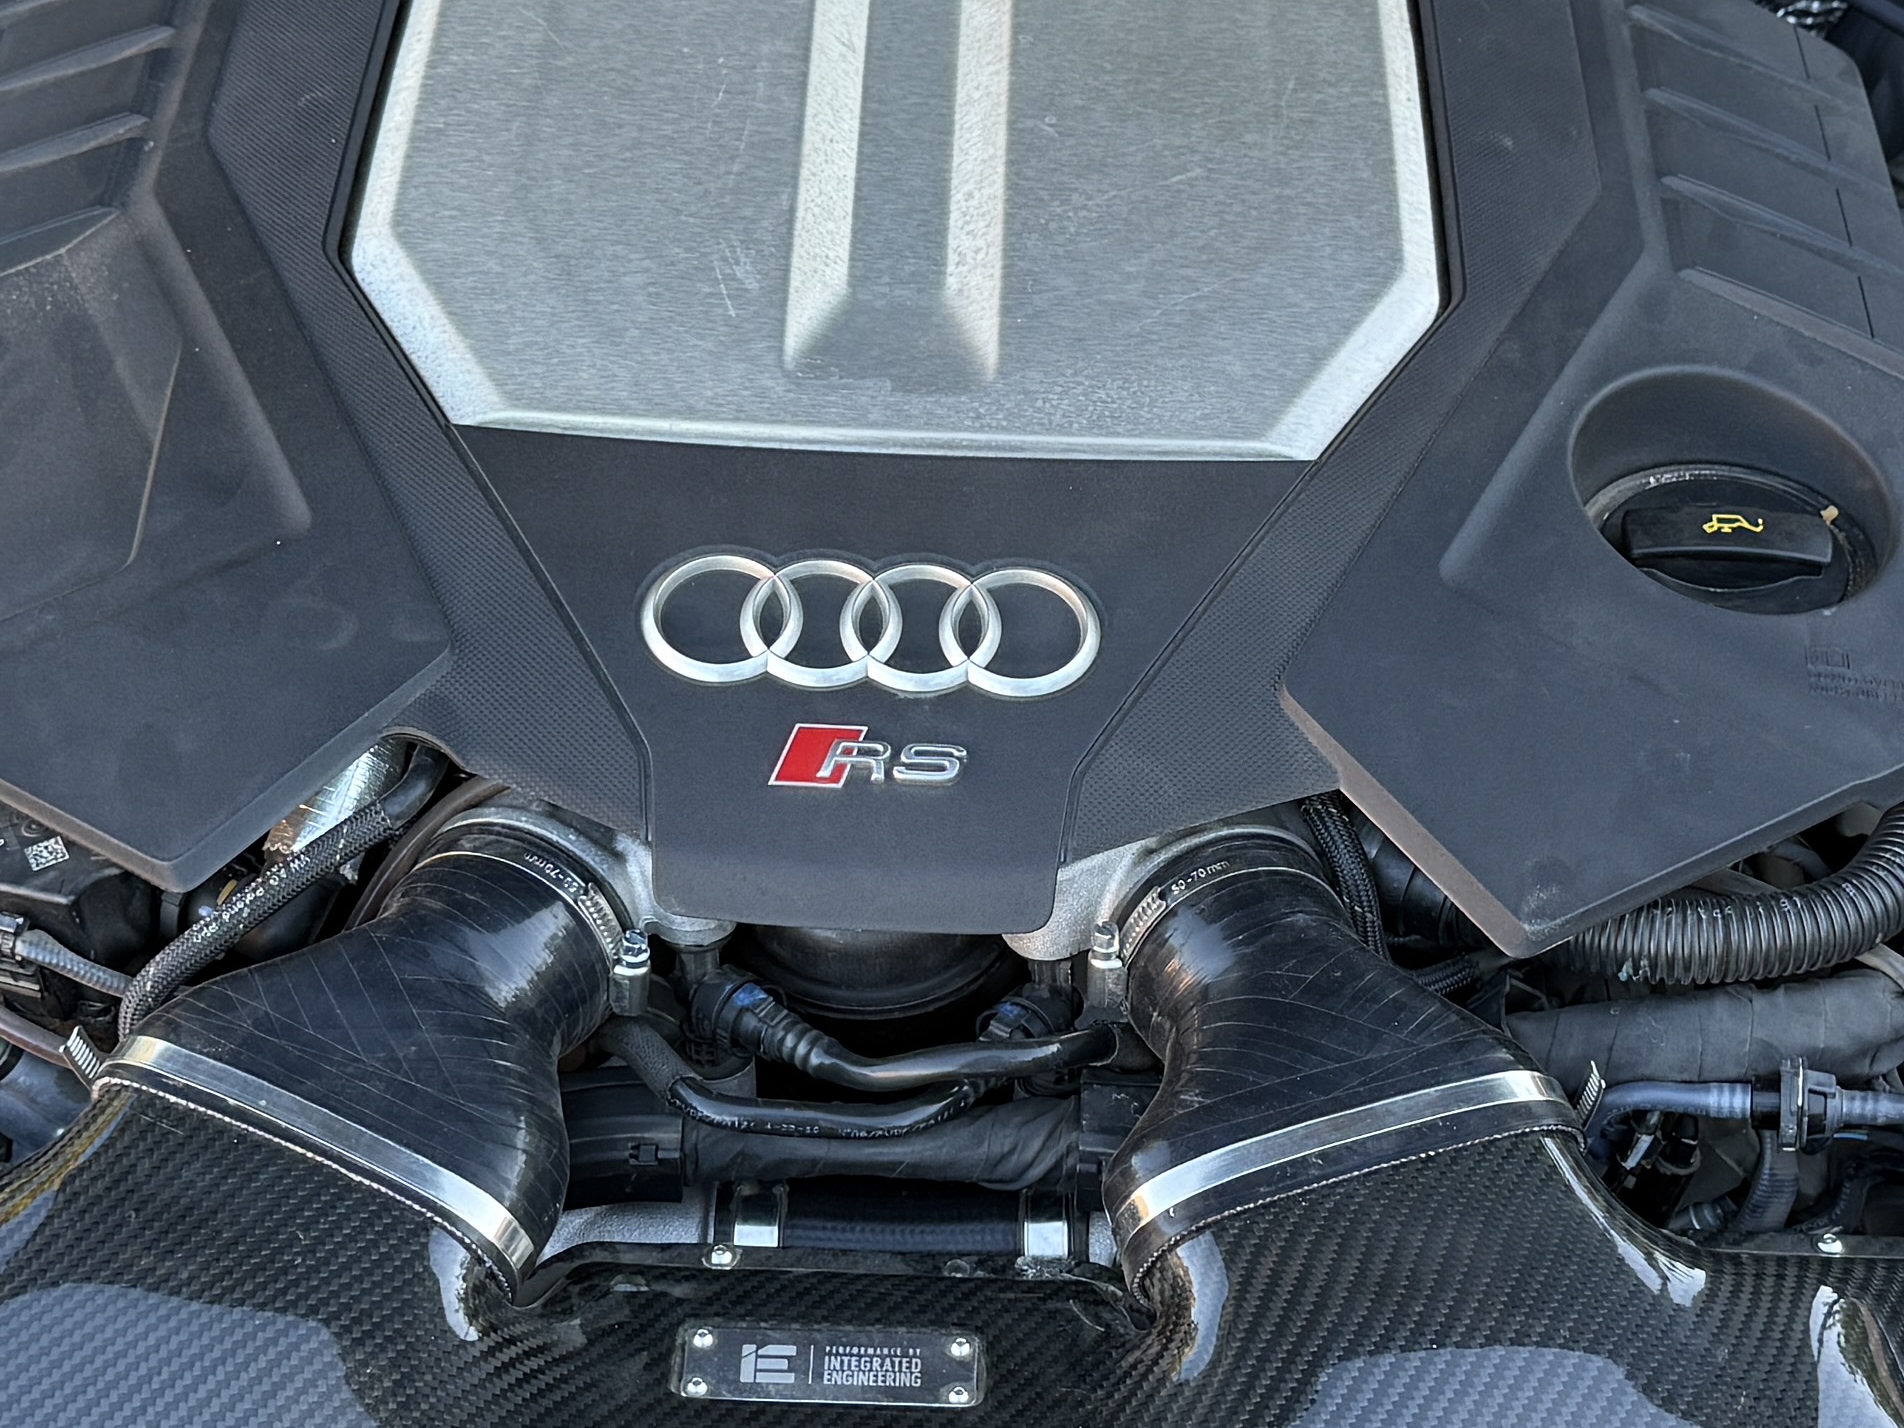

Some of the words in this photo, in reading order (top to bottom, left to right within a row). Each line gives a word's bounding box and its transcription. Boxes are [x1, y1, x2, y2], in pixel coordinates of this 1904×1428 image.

[815, 740, 969, 784] RS
[823, 1356, 922, 1372] INTEGRATED
[823, 1371, 922, 1387] ENGINEERING
